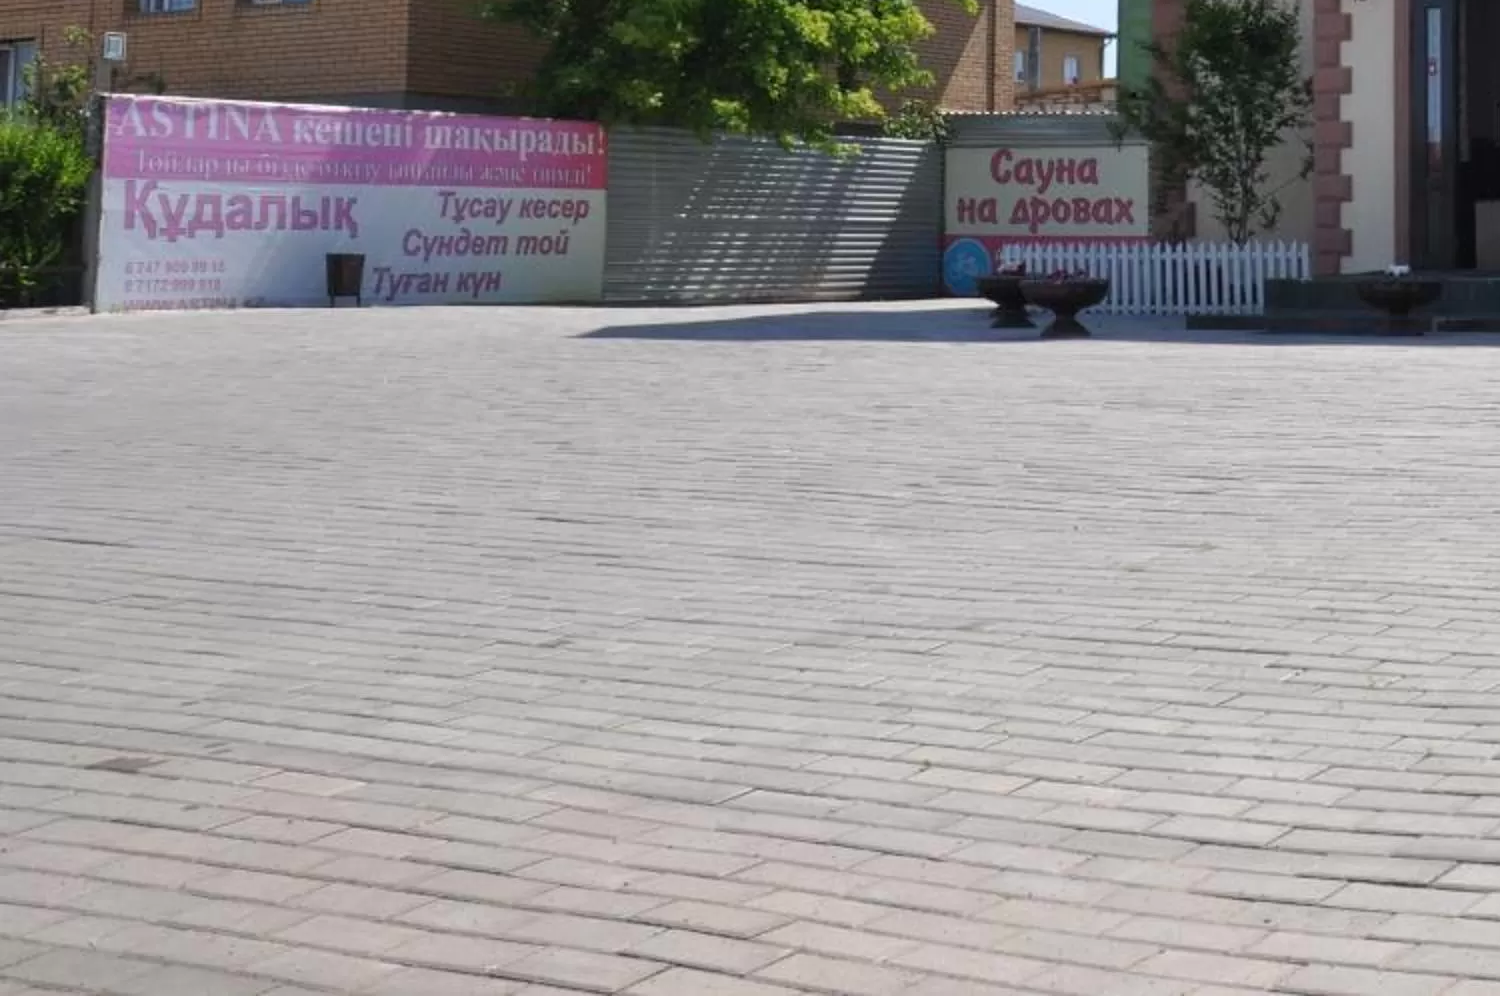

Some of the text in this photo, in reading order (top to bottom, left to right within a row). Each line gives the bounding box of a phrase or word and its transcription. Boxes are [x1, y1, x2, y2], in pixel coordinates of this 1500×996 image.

[113, 99, 606, 161] ASTINA кешені шақырады!
[989, 148, 1099, 194] Сауна
[123, 180, 359, 243] Құдалық
[438, 191, 591, 225] Тұсау кесер
[957, 196, 1135, 234] на дровах
[402, 227, 570, 262] Сүндет той
[372, 266, 502, 301] Туған күн
